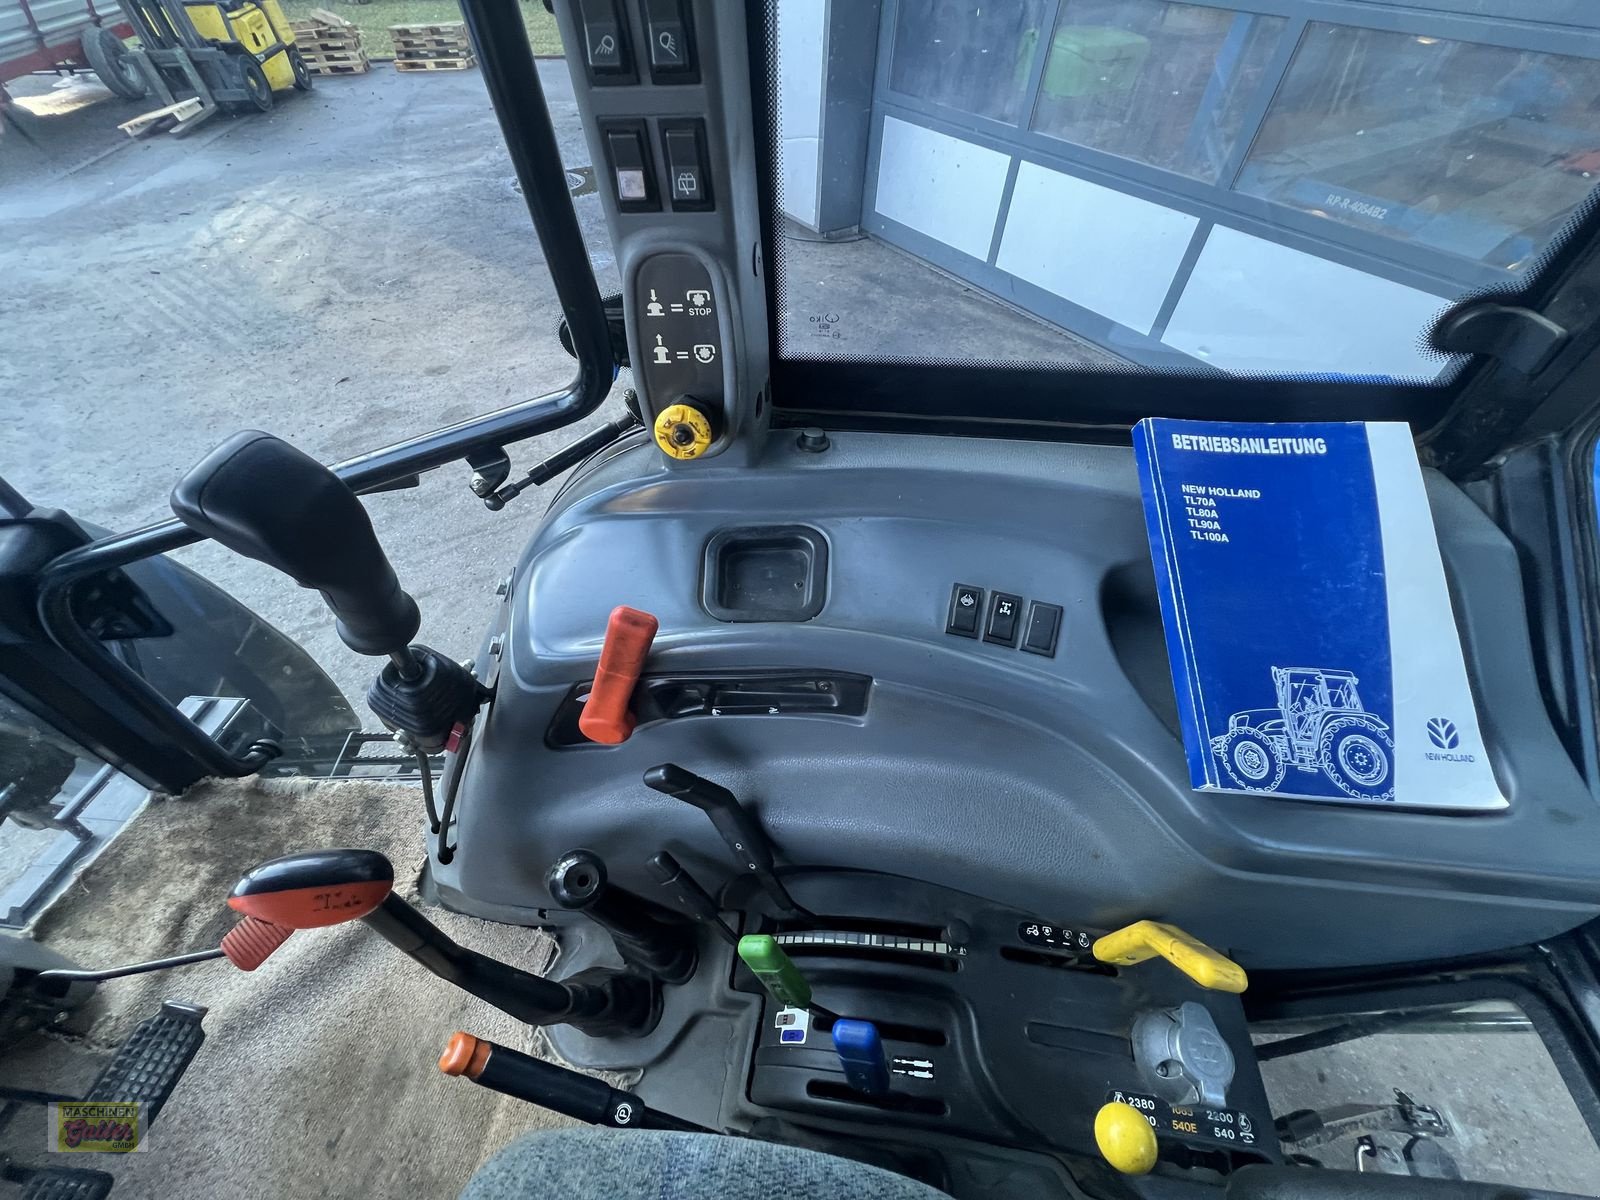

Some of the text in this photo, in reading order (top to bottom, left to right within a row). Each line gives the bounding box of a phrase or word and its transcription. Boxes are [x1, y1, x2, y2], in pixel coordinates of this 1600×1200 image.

[688, 307, 712, 317] STOP
[1171, 433, 1328, 455] BETRIEBSANLEITUNG
[1181, 484, 1261, 499] NEW HOLLAND
[1183, 495, 1216, 507] TL70A
[1185, 506, 1219, 519] TL80A
[1187, 518, 1221, 531] TL90A
[1190, 530, 1230, 543] TL100A
[1425, 752, 1476, 763] NEW HOLLAND
[1128, 1096, 1155, 1110] 2380
[1206, 1110, 1234, 1124] 2200
[1172, 1119, 1198, 1134] 540E
[1214, 1127, 1235, 1140] 540
